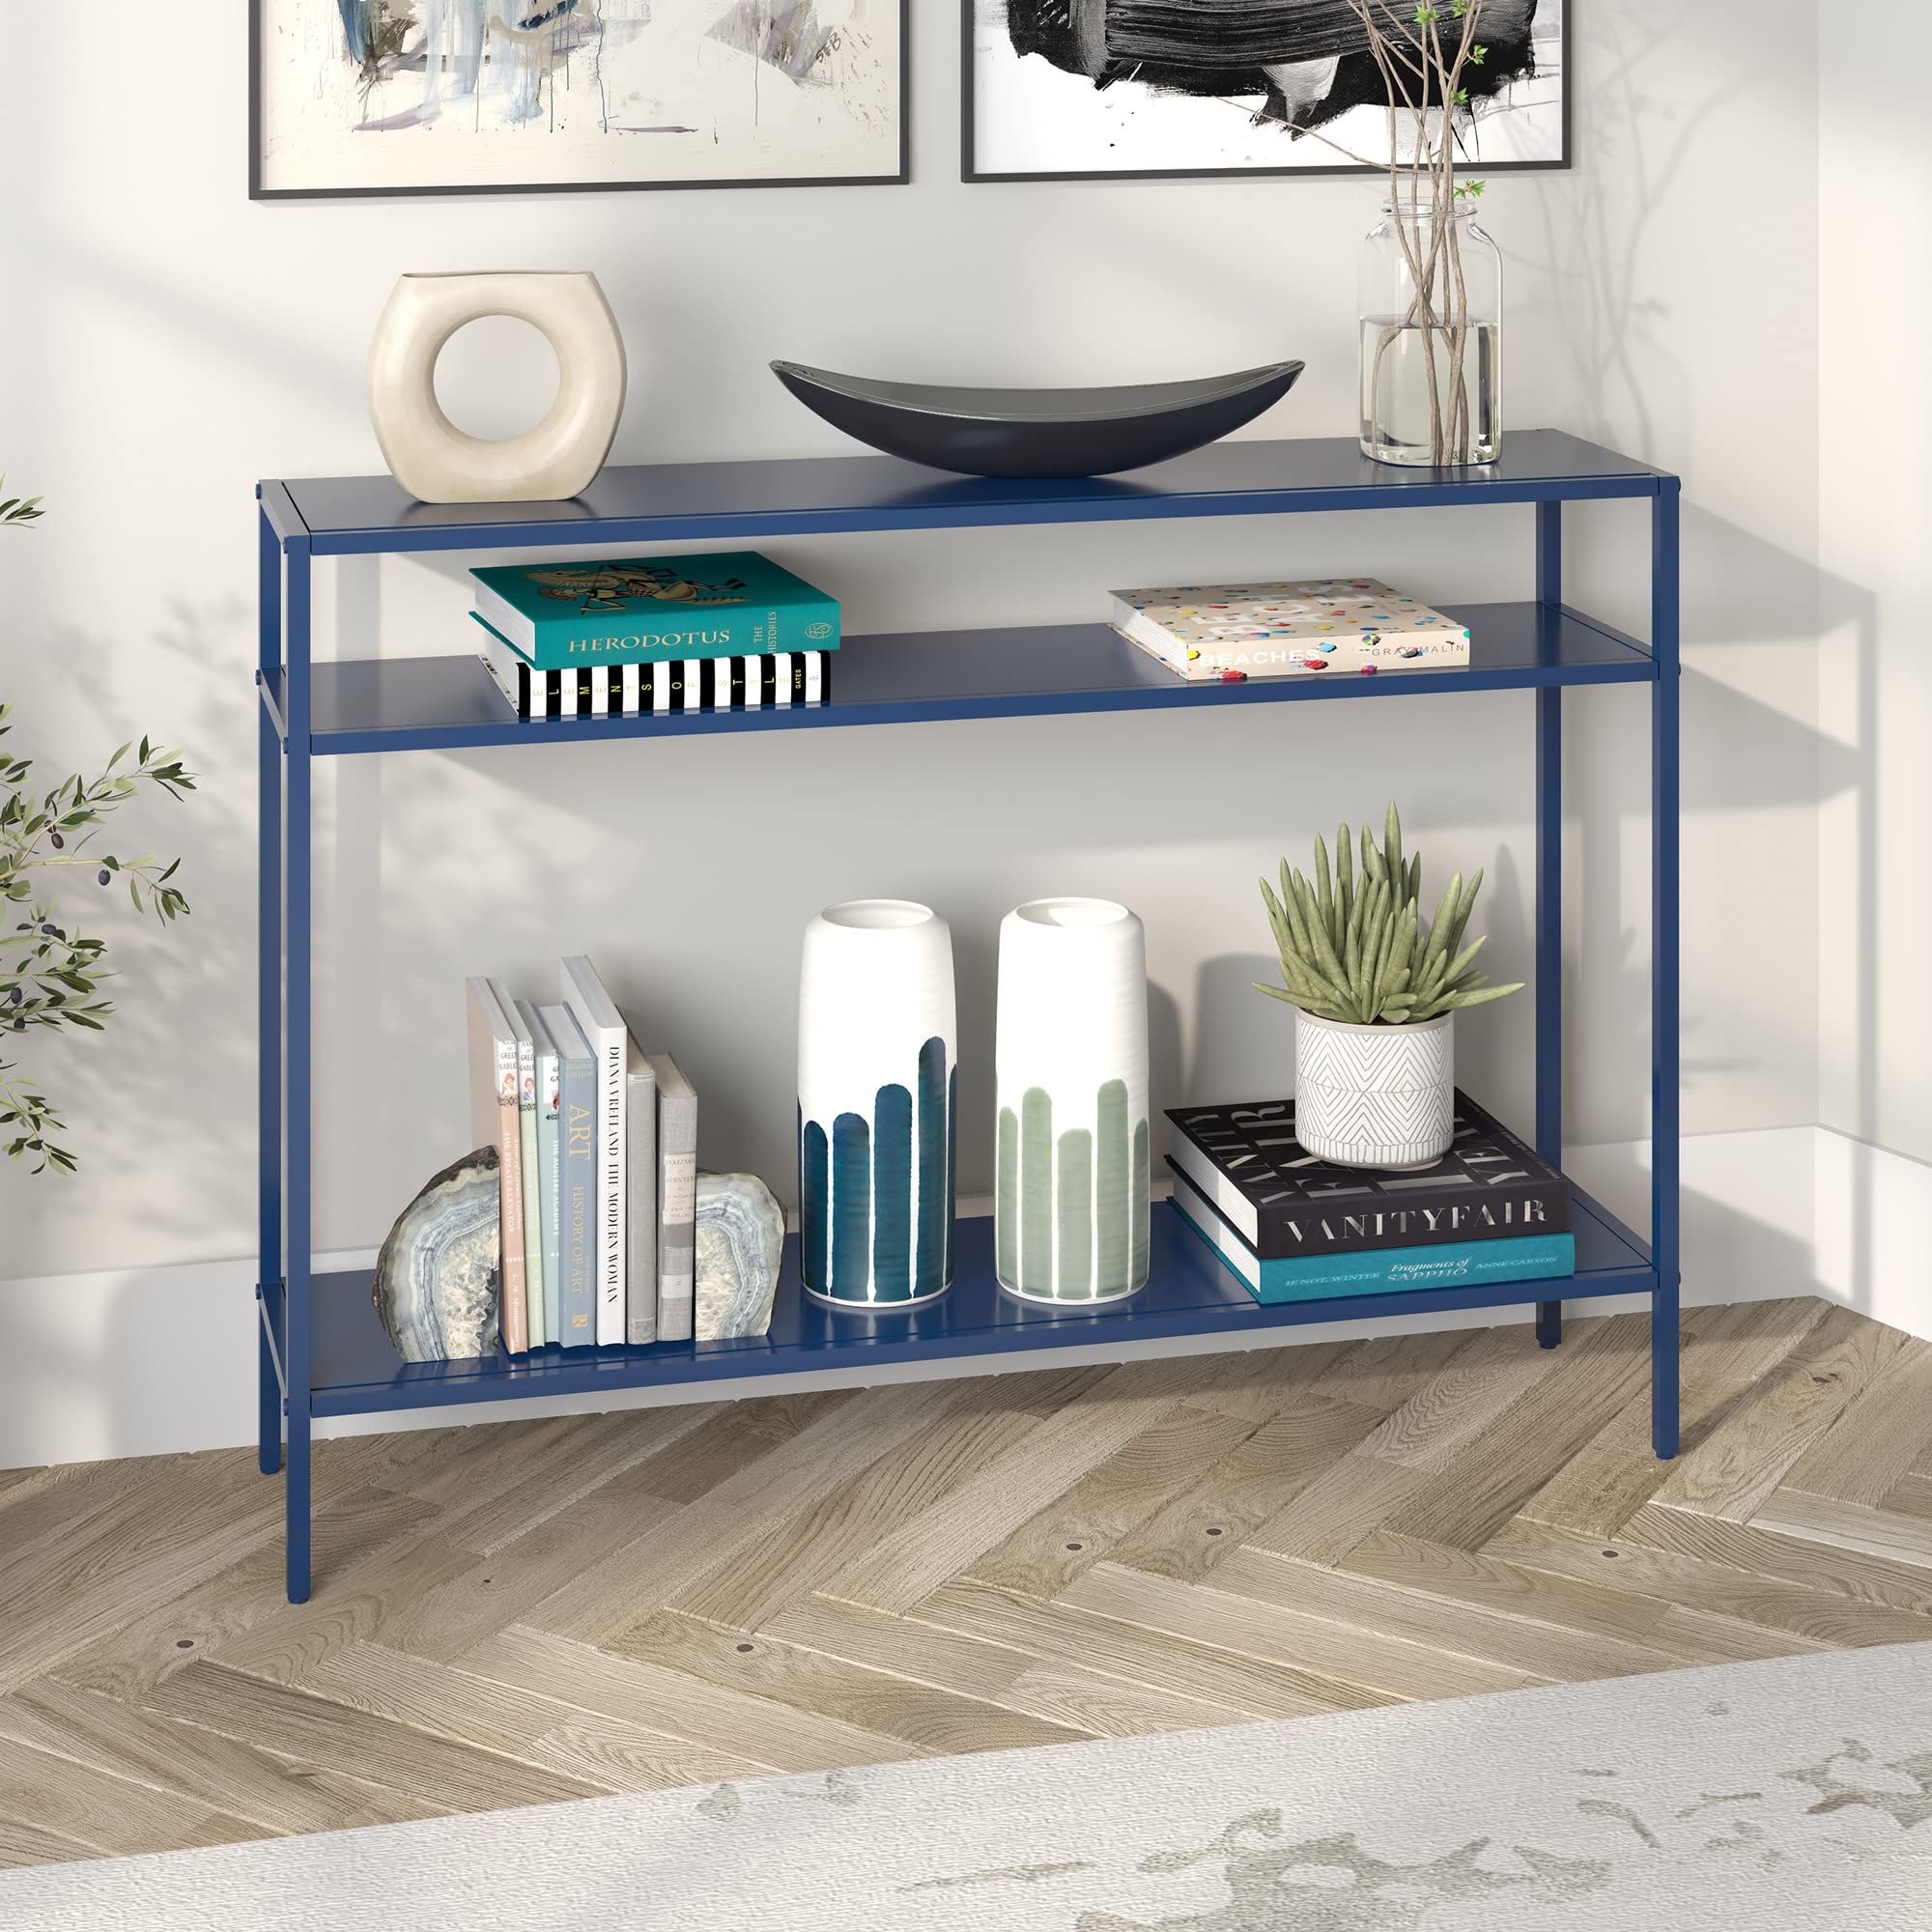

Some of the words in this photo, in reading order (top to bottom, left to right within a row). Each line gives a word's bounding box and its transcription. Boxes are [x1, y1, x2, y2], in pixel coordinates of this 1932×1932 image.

[567, 629, 730, 653] HERODOTUS
[753, 626, 763, 643] THE
[767, 611, 778, 654] HISTORIES
[1198, 648, 1321, 667] BEACHES
[1419, 644, 1464, 654] MALIN
[609, 1046, 619, 1087] DIANA
[569, 1102, 591, 1161] ART
[609, 1090, 619, 1156] VREELAND
[608, 1164, 619, 1188] THE
[572, 1185, 584, 1243] HISTORY
[608, 1192, 619, 1249] MODERN
[572, 1246, 583, 1264] OF
[1390, 1261, 1455, 1272] Fragments
[1456, 1257, 1472, 1267] of
[572, 1268, 582, 1293] ART
[607, 1253, 618, 1302] WOMAN
[1386, 1268, 1467, 1282] SAPPHO
